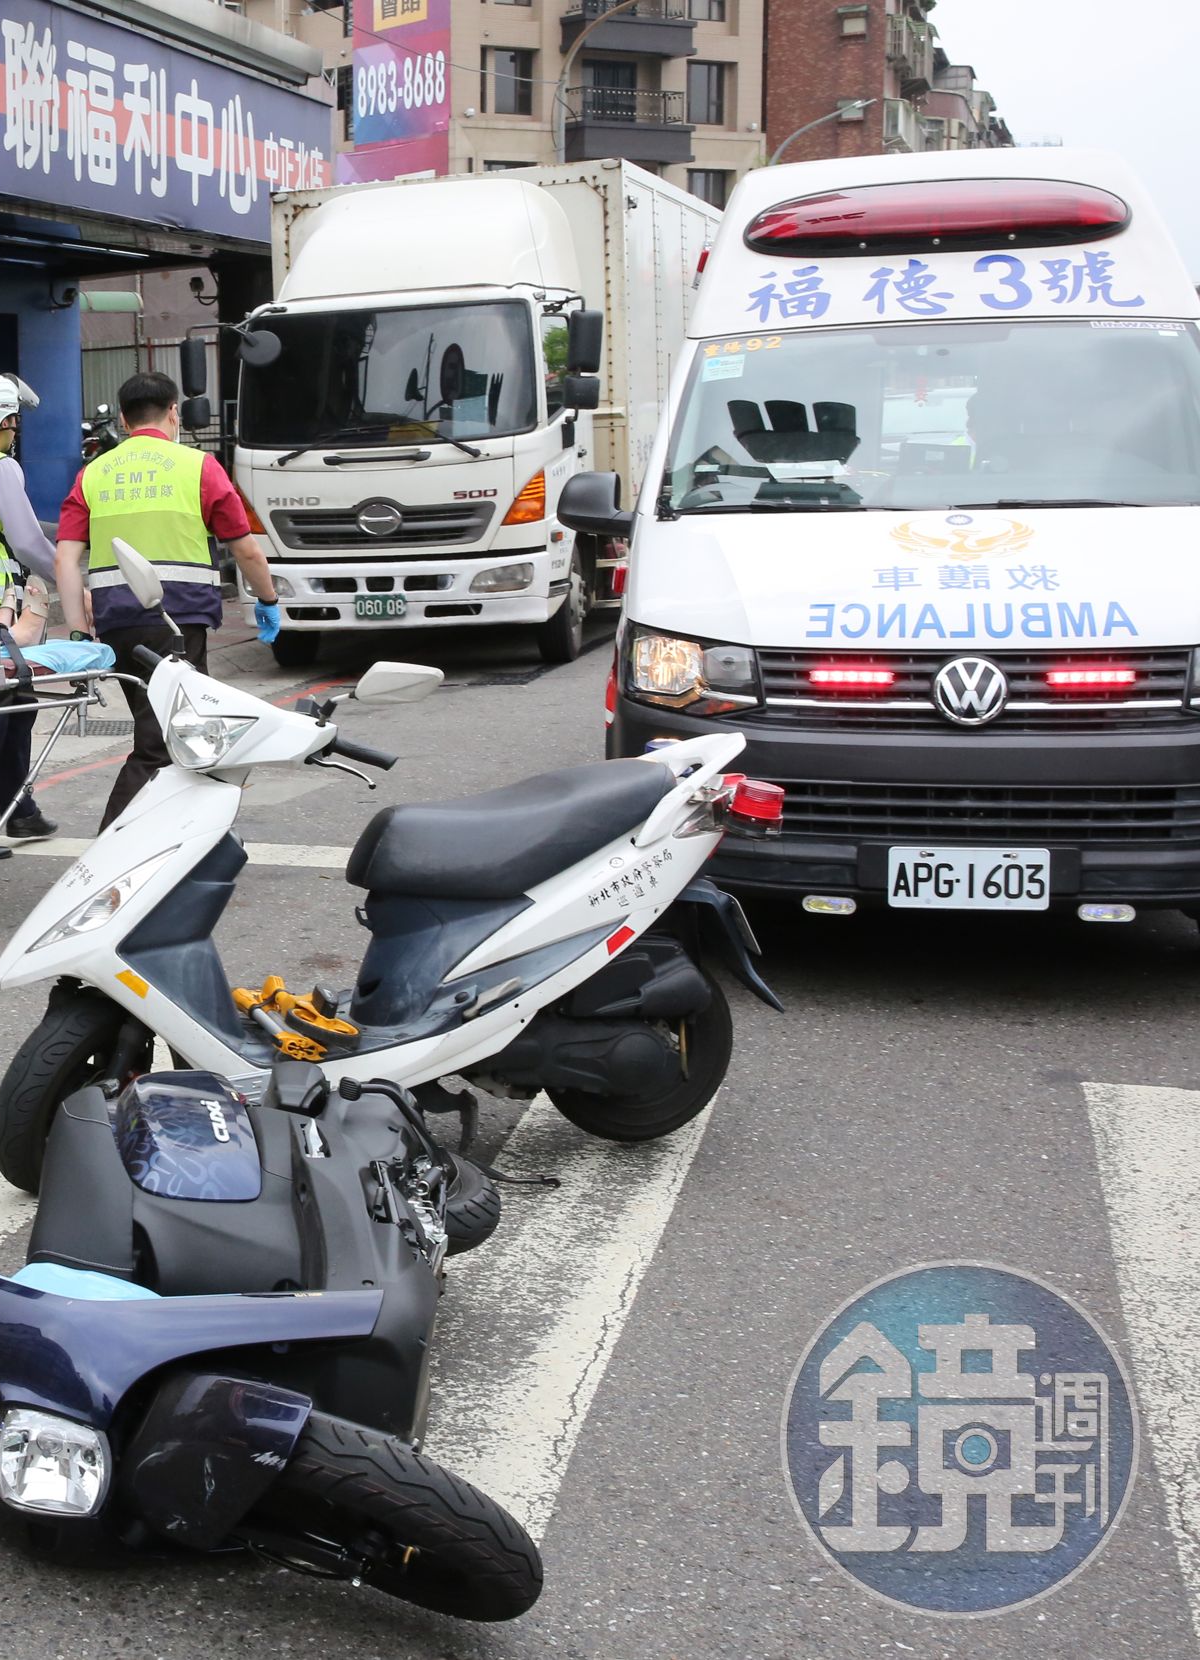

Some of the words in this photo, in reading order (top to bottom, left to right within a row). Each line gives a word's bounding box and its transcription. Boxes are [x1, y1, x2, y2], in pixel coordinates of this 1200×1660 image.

[358, 50, 445, 118] 8983-8688
[746, 250, 1145, 323] 福德3號
[115, 470, 158, 485] EMT
[267, 496, 321, 507] HINO
[453, 489, 498, 500] 500
[893, 862, 1045, 900] APG-1603
